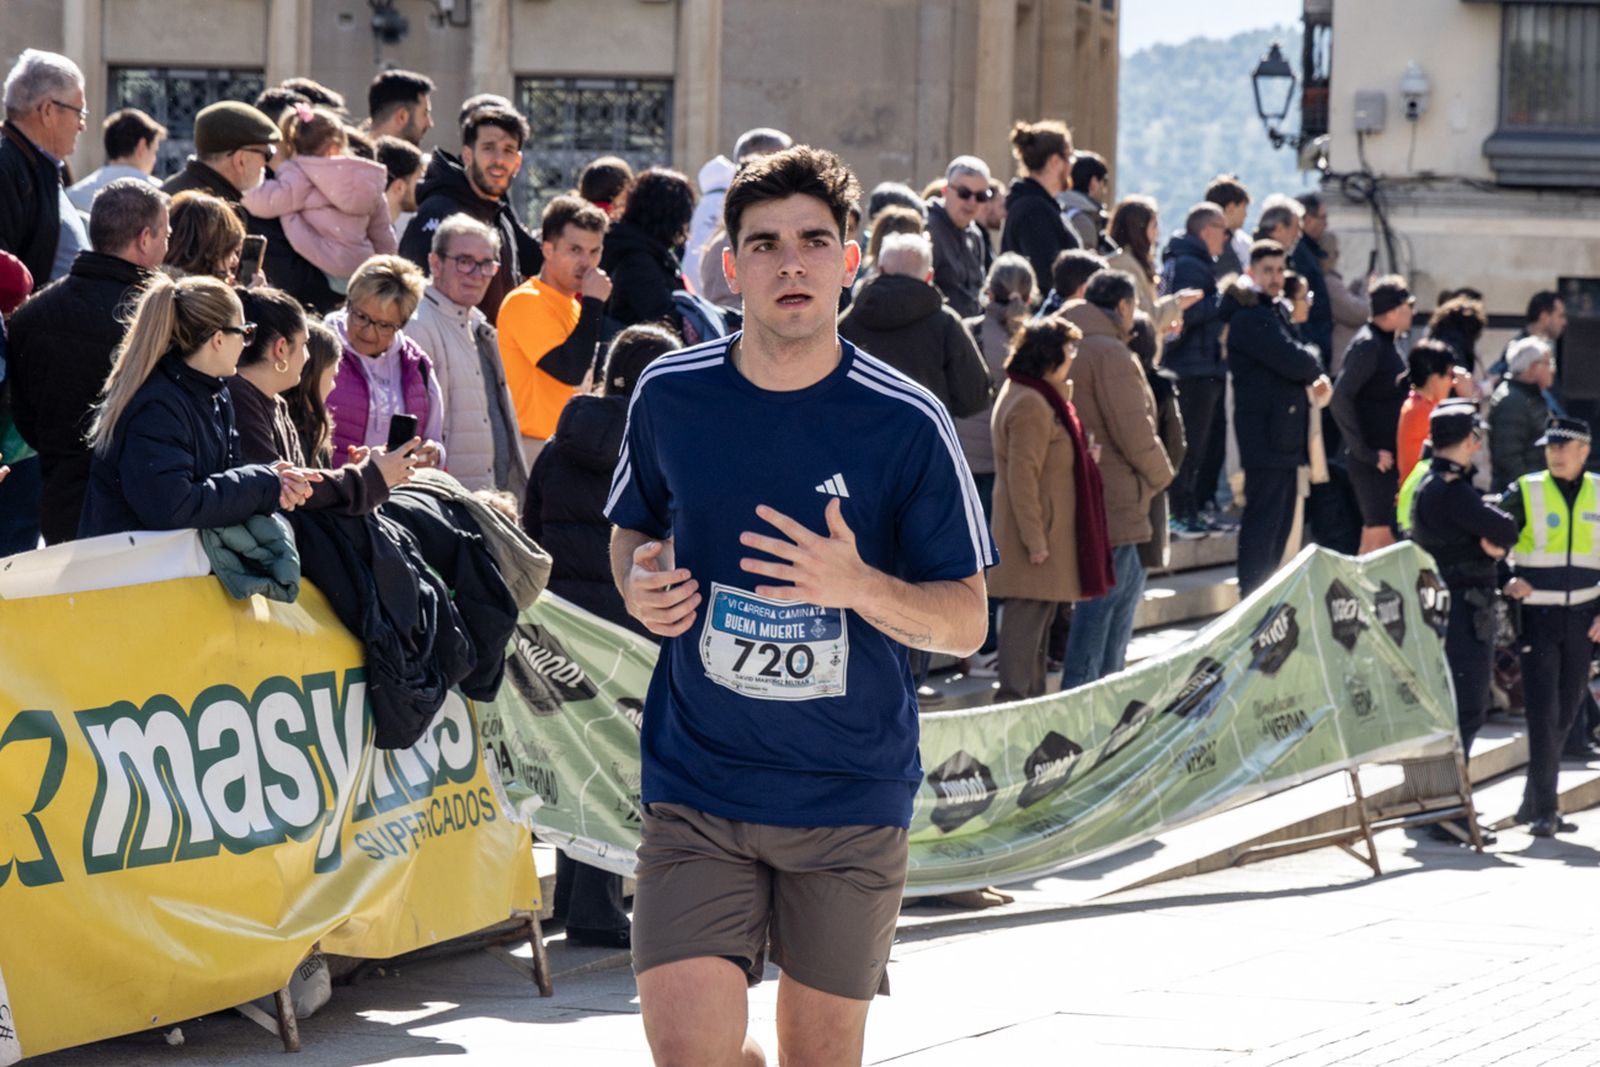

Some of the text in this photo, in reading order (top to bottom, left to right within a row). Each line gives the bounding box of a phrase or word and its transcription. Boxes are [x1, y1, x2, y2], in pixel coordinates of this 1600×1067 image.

[727, 599, 827, 619] VI CARRERA CAMINATA
[724, 612, 806, 639] BUENA MUERTE
[731, 637, 815, 680] 720
